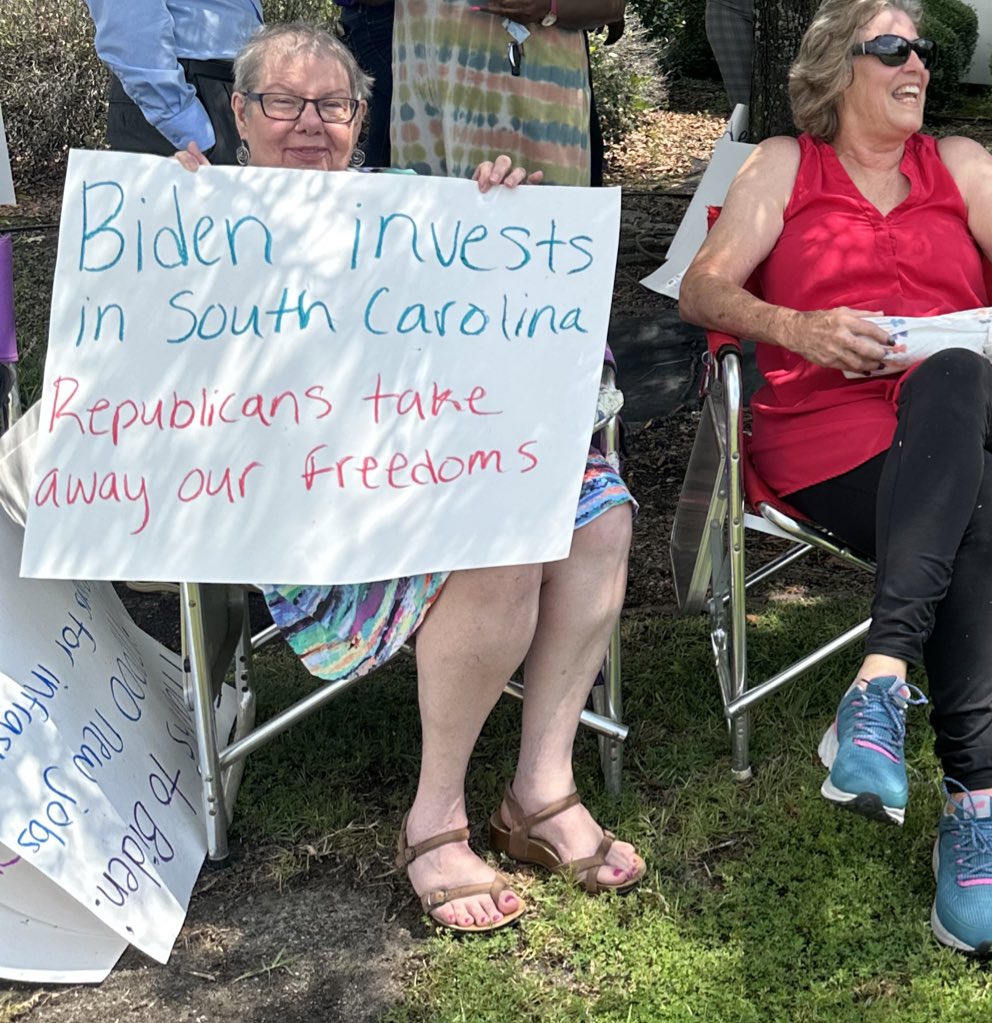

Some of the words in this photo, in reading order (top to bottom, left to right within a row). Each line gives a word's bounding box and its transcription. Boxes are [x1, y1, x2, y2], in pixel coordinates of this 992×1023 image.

[79, 181, 272, 272] Biden
[351, 204, 593, 274] invests
[76, 297, 124, 347] in
[167, 288, 336, 343] South
[364, 287, 587, 340] Carolina
[49, 376, 332, 446] Republicans
[363, 373, 503, 425] take
[35, 468, 149, 534] away
[178, 461, 263, 503] our
[301, 440, 538, 492] freedoms
[56, 611, 96, 668] for
[0, 663, 68, 760] infras
[73, 708, 124, 783] new
[18, 765, 89, 853] jobs
[149, 753, 197, 815] to
